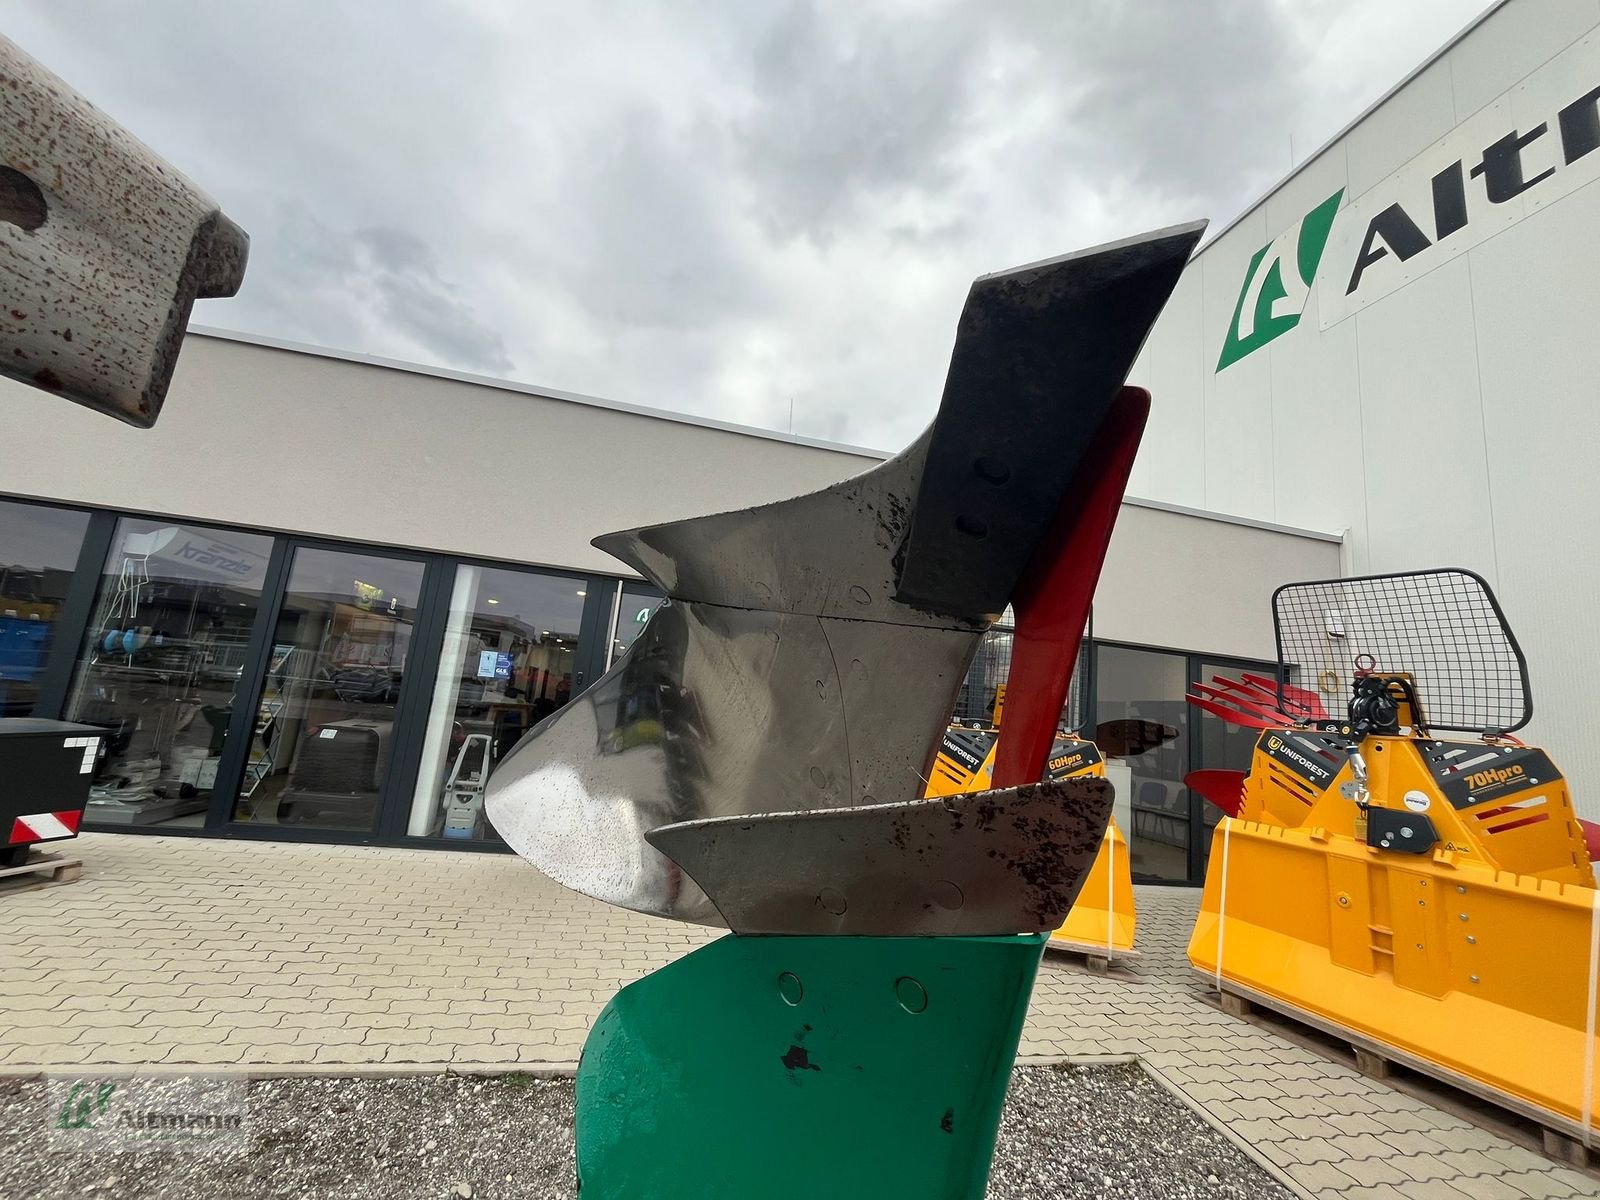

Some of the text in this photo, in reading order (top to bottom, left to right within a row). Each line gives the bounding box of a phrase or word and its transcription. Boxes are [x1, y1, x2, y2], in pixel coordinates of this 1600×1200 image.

[943, 739, 980, 766] UNIFOREST
[1048, 753, 1082, 770] 60Hpro
[1280, 745, 1330, 779] UNIFOREST
[1463, 764, 1523, 790] 70Hpro
